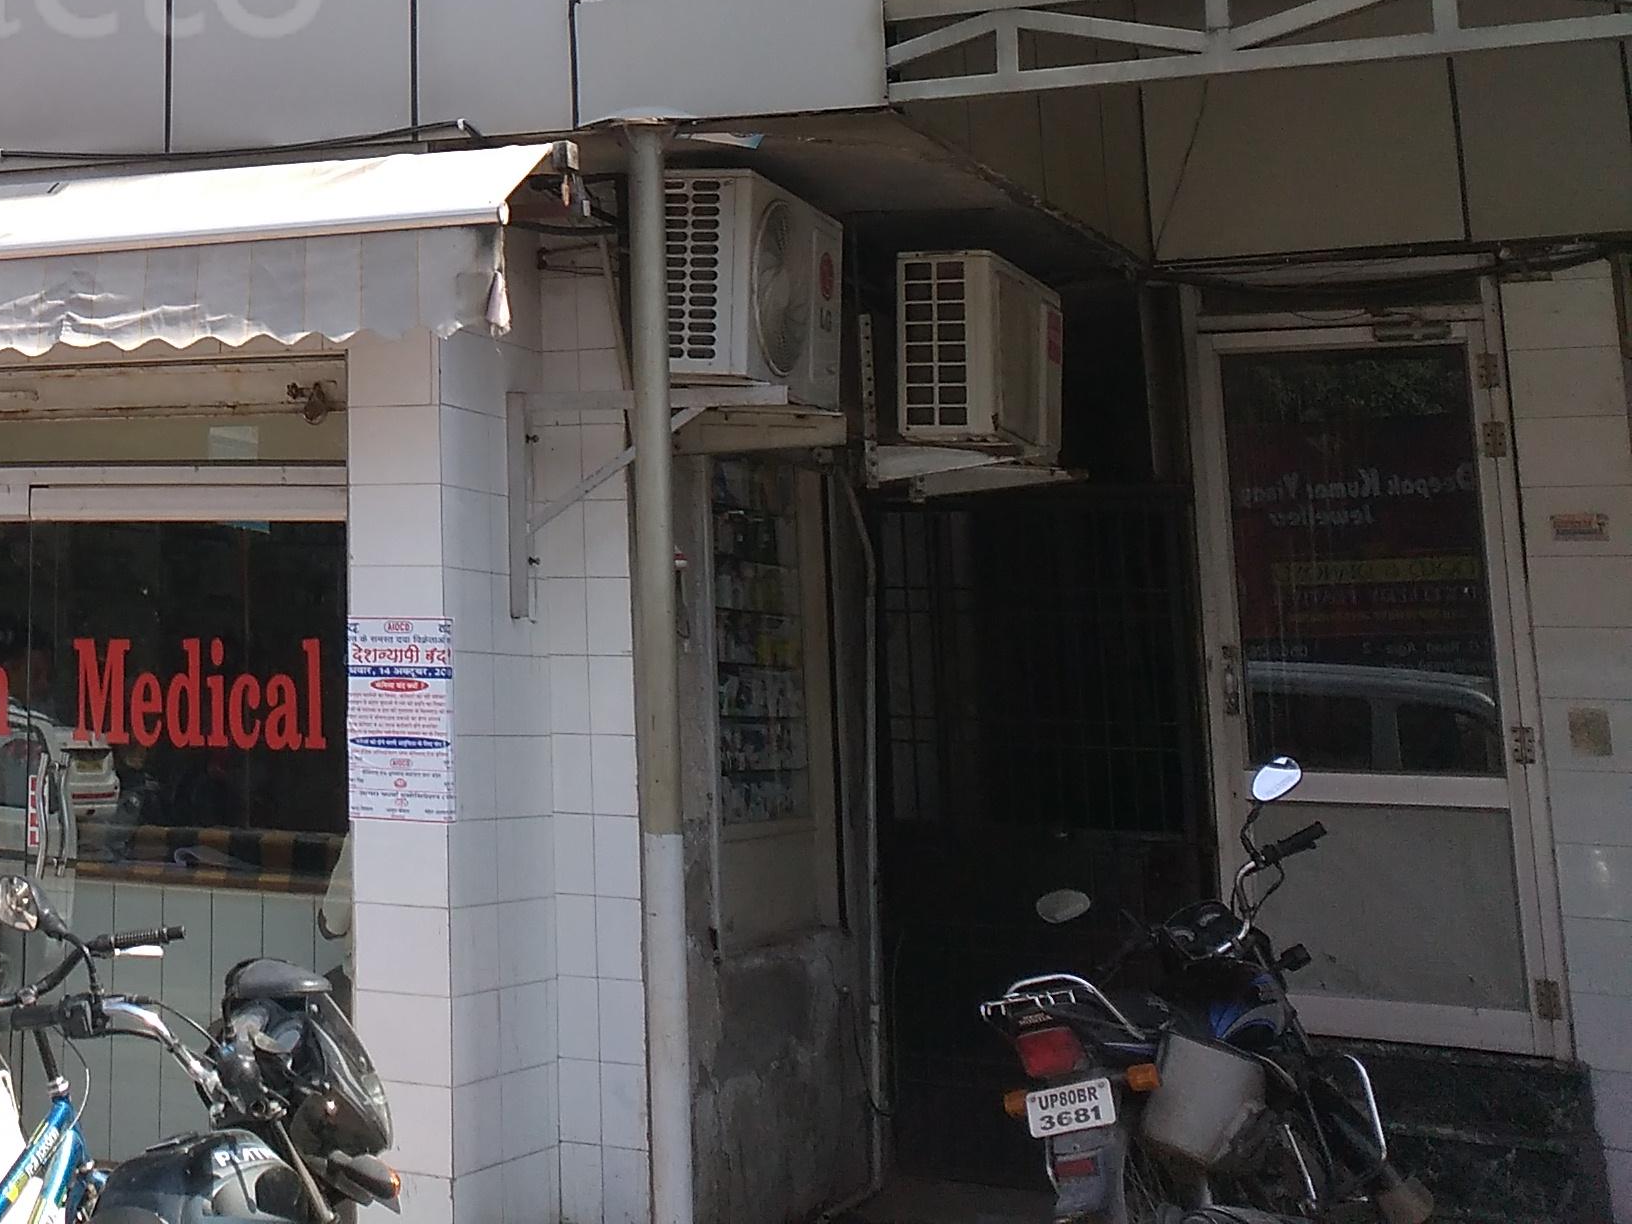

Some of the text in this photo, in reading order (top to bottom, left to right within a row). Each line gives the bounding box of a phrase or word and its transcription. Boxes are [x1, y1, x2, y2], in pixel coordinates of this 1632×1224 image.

[71, 637, 328, 751] Medical
[1037, 1085, 1100, 1112] UP80BR
[1039, 1105, 1103, 1132] 3681
